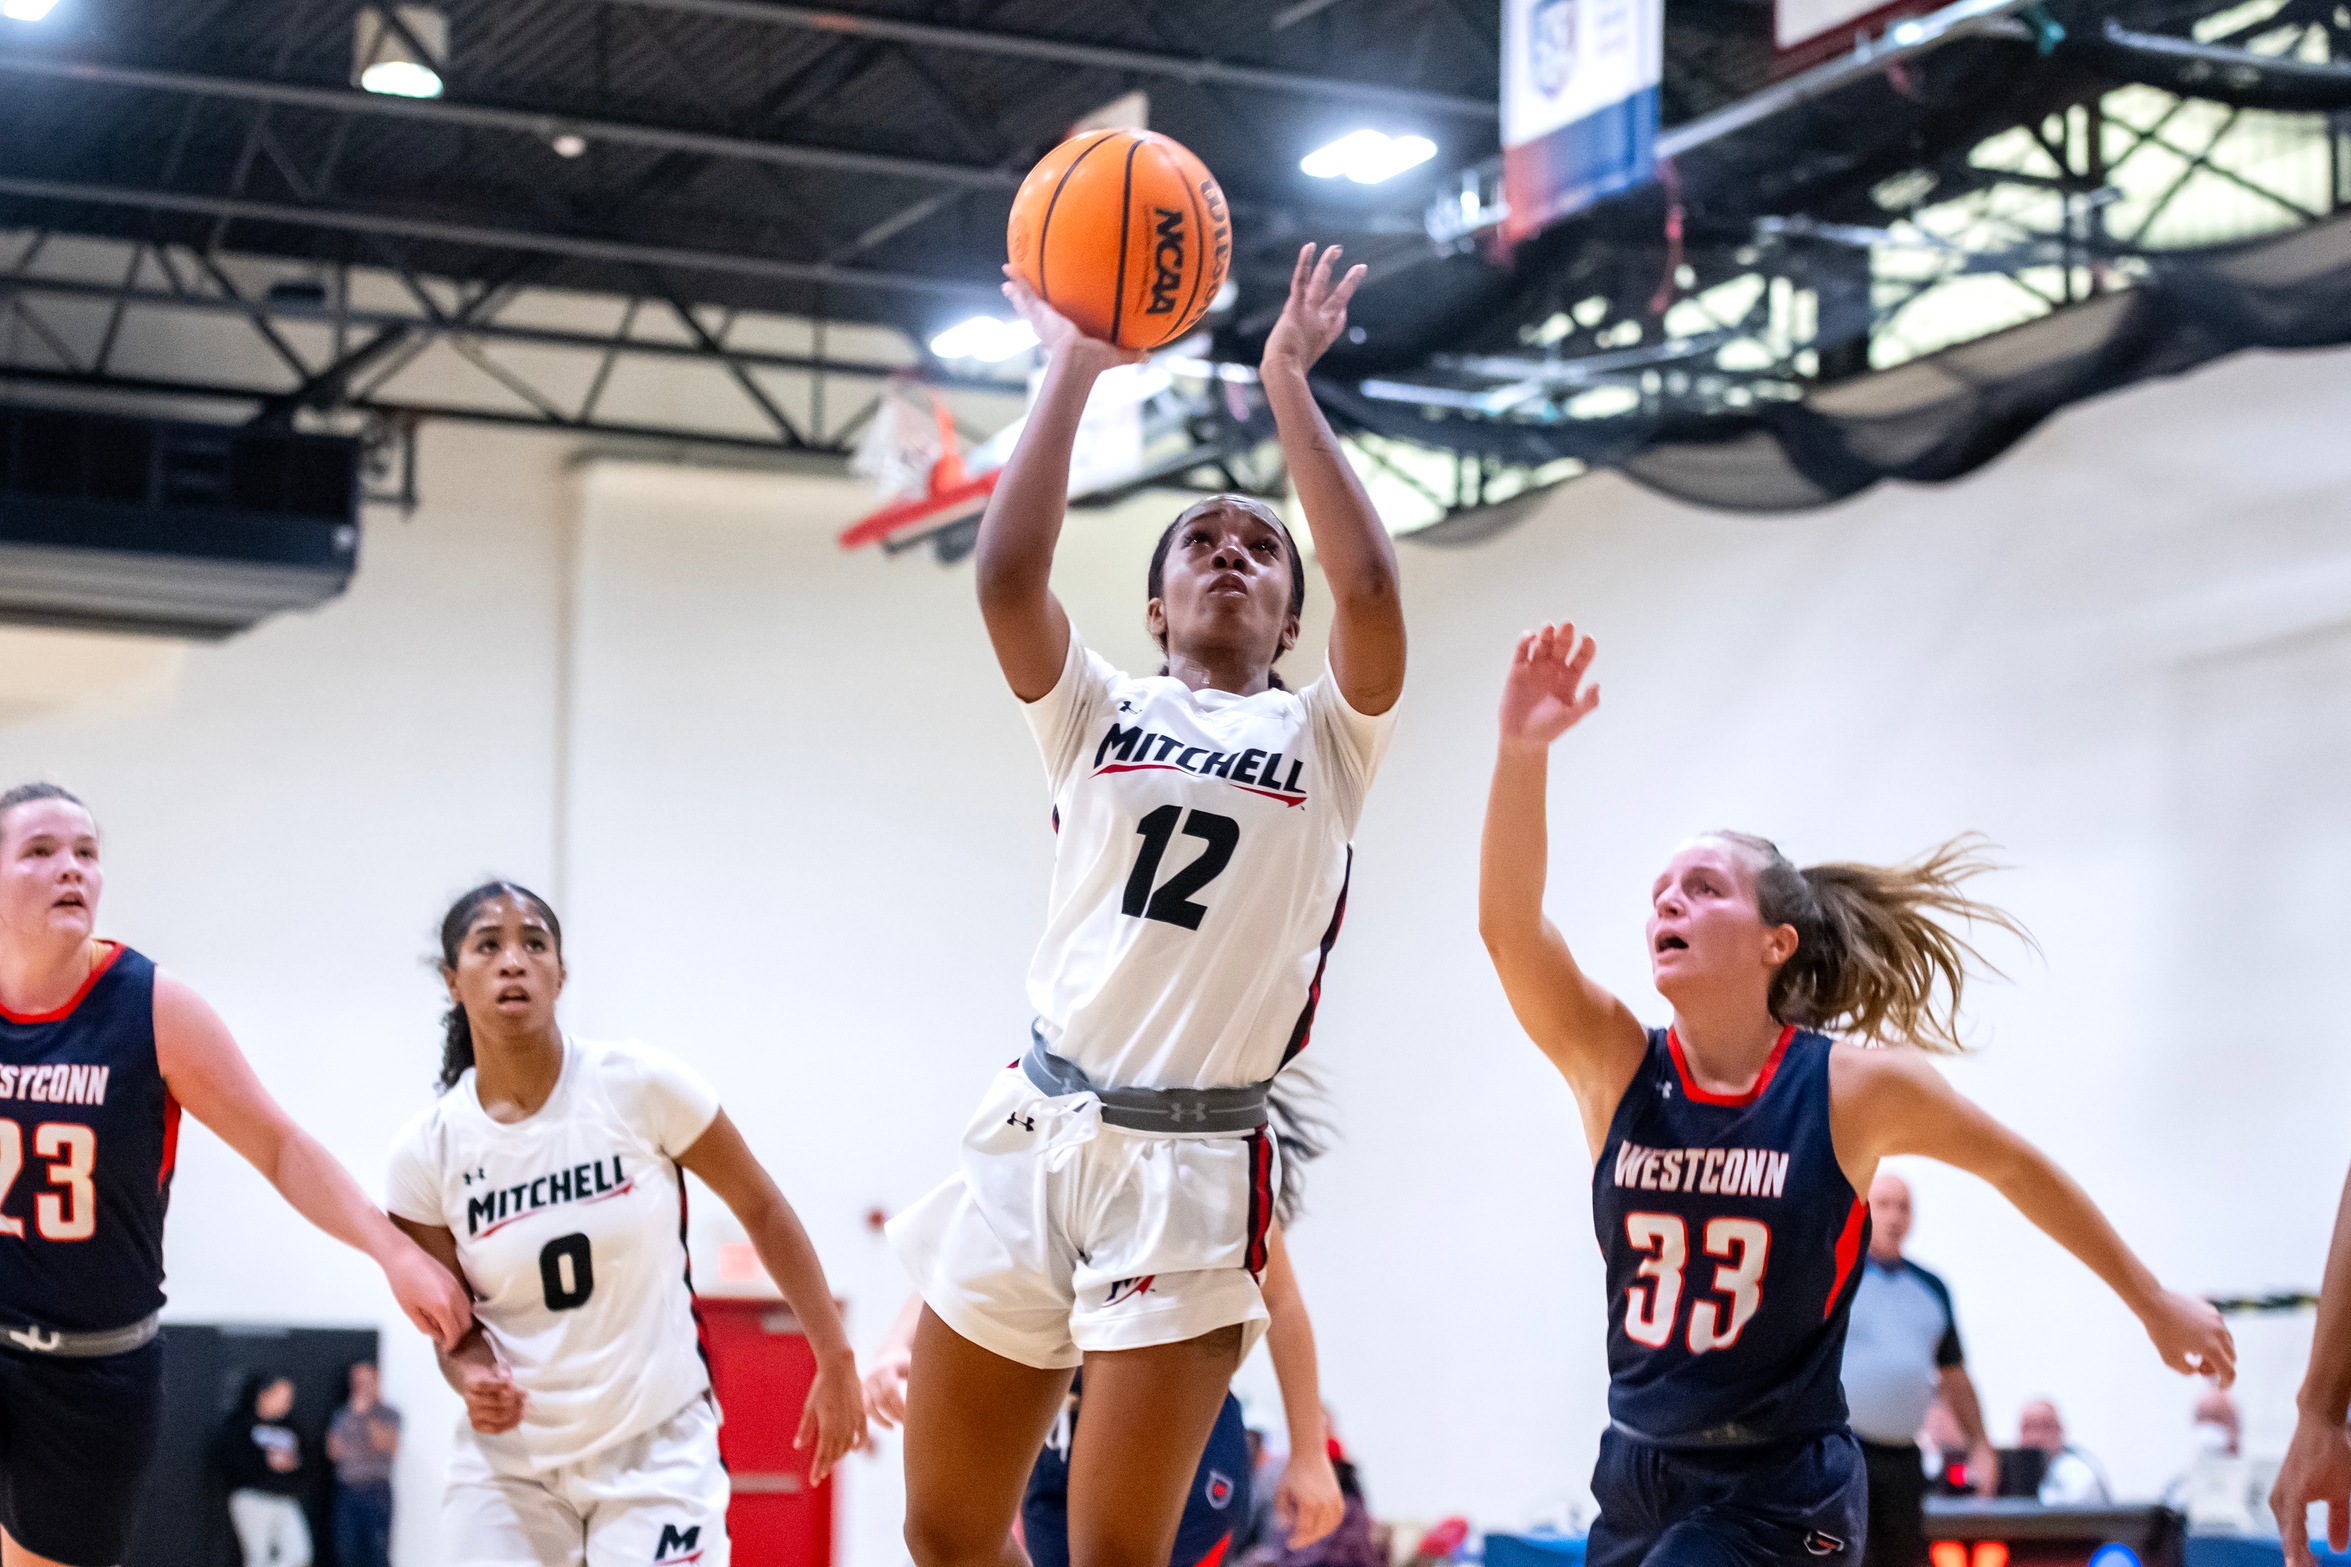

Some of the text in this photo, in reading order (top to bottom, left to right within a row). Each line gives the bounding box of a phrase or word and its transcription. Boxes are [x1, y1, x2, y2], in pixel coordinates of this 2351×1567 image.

[1145, 207, 1184, 315] NCAA
[1094, 723, 1306, 794] MITCHELL
[1121, 804, 1240, 931] 12
[0, 1063, 110, 1106] STCONN
[467, 1155, 625, 1236] MITCHELL
[1614, 1139, 1790, 1198] WESTCONN
[539, 1232, 594, 1312] 0
[1624, 1210, 1772, 1355] 33
[654, 1523, 702, 1561] M
